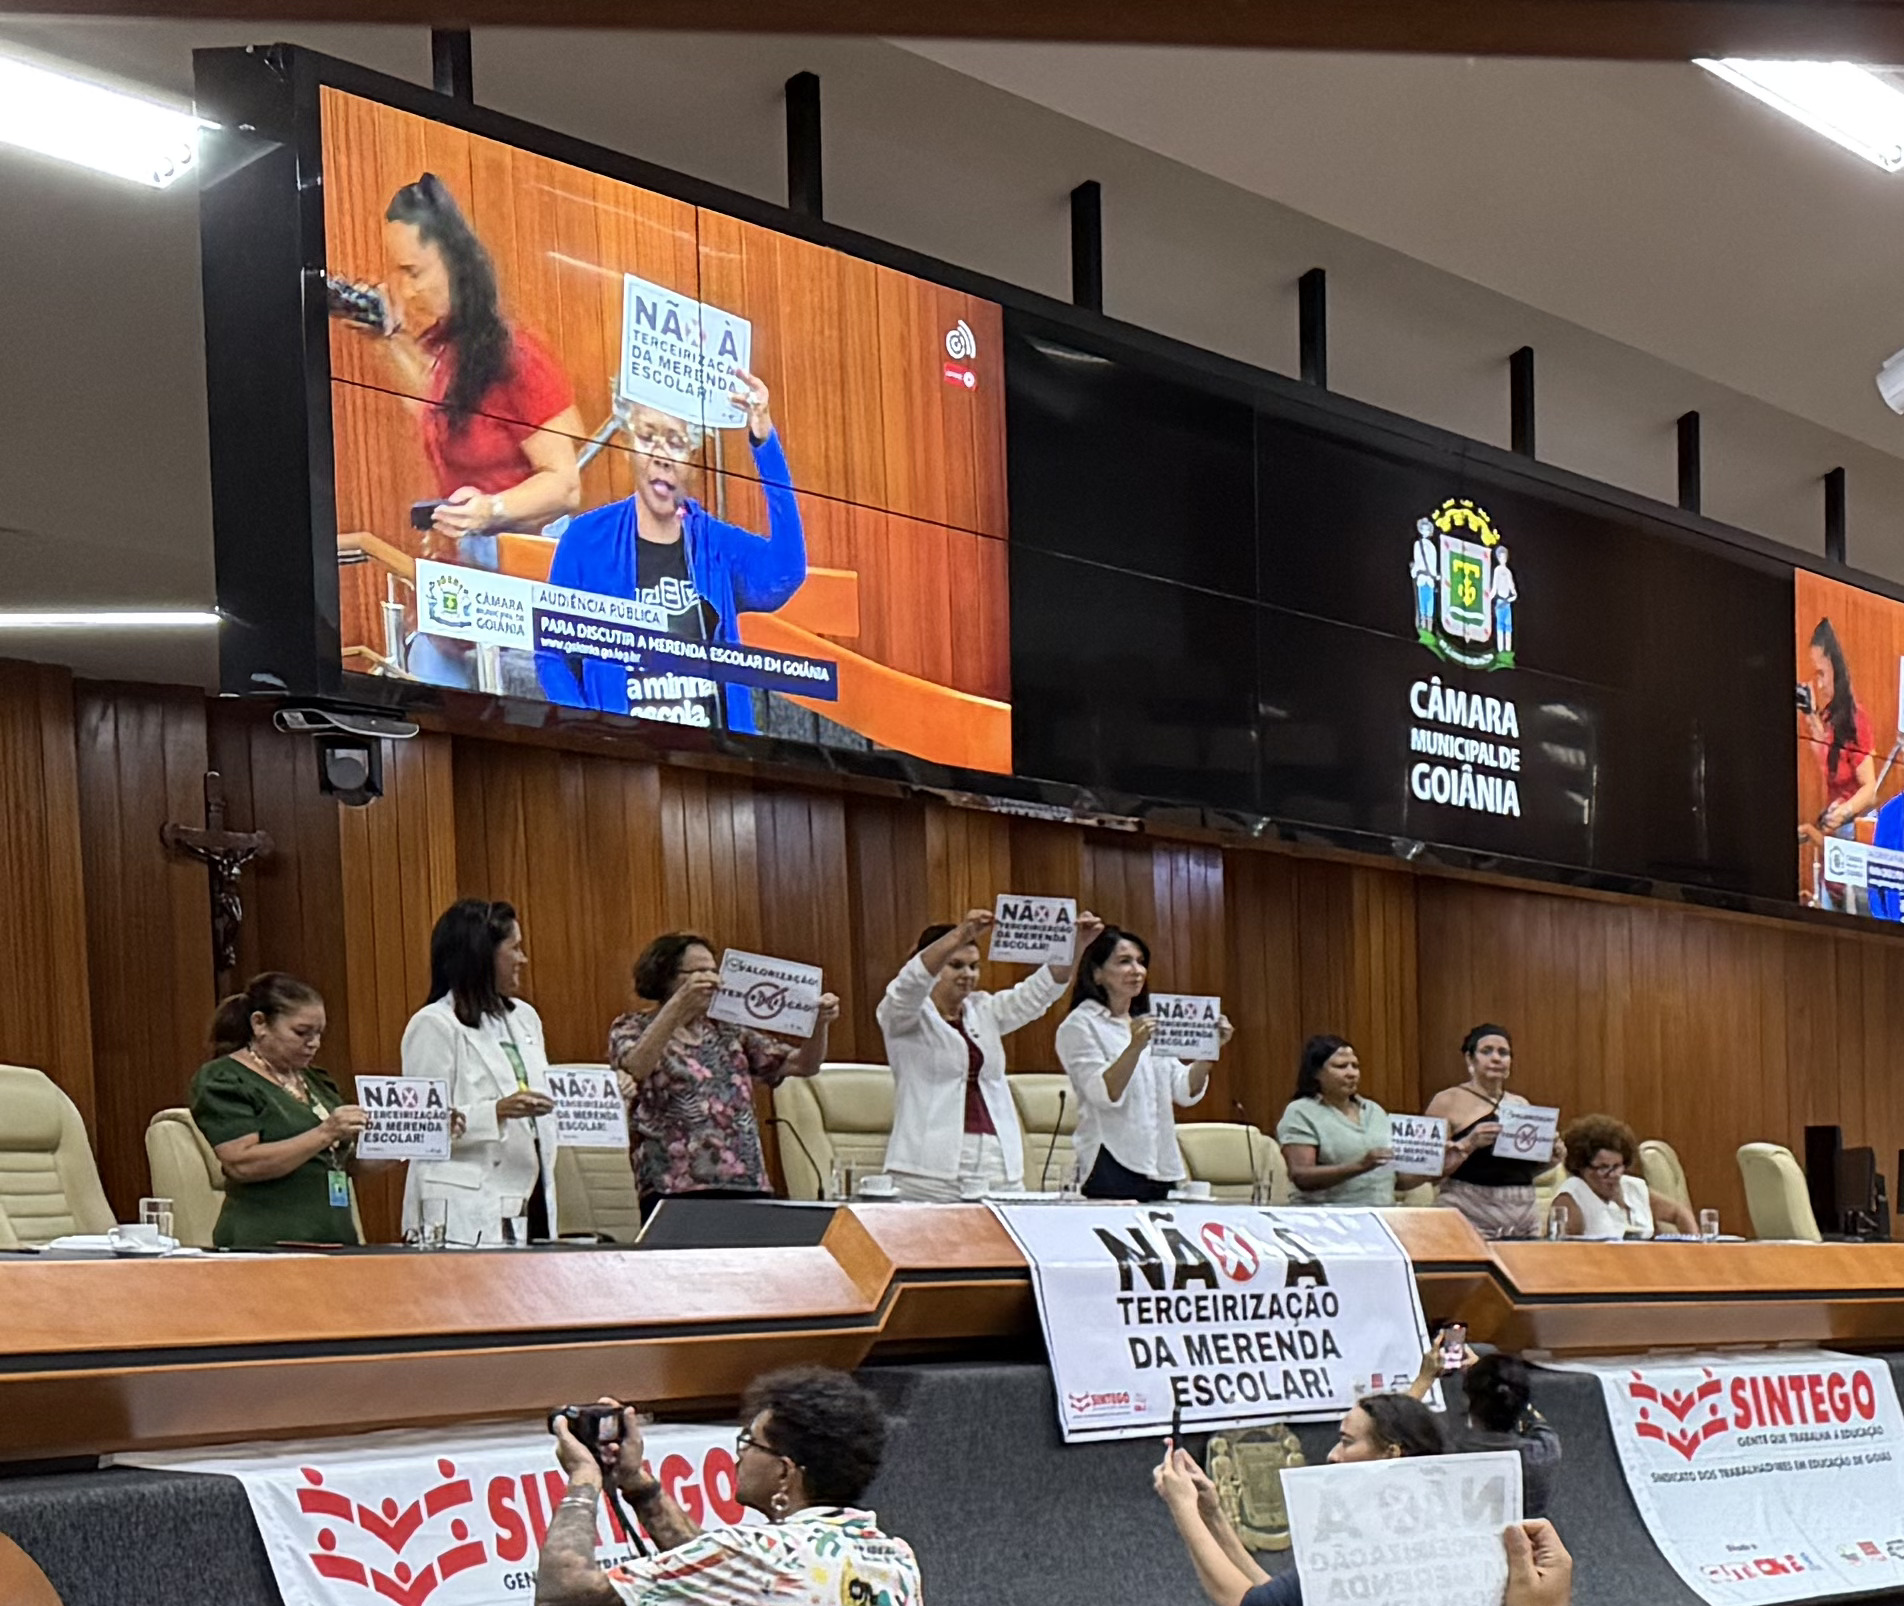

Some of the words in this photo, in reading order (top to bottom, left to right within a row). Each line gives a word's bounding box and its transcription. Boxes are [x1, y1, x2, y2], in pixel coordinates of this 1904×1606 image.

[632, 344, 653, 365] DA
[540, 616, 576, 638] PARA
[637, 634, 647, 649] A
[710, 646, 763, 670] ESCOLAR
[1409, 675, 1520, 739] CÂMARA
[1410, 727, 1499, 768] MUNICIPAL
[1499, 745, 1521, 772] DE
[1411, 761, 1521, 817] GOIÂNIA
[996, 930, 1011, 938] DA
[426, 1081, 443, 1108] À
[602, 1073, 618, 1099] À
[363, 1132, 425, 1144] ESCOLAR!
[364, 1121, 382, 1131] DA
[385, 1121, 443, 1132] MERENDA
[1116, 1285, 1340, 1328] TERCEIRIZAÇÃO
[1128, 1335, 1179, 1370] DA
[1183, 1328, 1343, 1367] MERENDA
[1169, 1366, 1335, 1409] ESCOLAR!
[1729, 1369, 1876, 1431] SINTEGO
[1737, 1433, 1769, 1448] GENTE
[1770, 1432, 1787, 1445] QUE
[1789, 1430, 1832, 1444] TRABALHA
[1840, 1425, 1884, 1441] EDUCAÇÃO
[1651, 1471, 1697, 1484] SINDICATO
[1698, 1470, 1718, 1481] DOS
[1808, 1456, 1851, 1472] EDUCAÇÃO
[1852, 1455, 1864, 1466] DE
